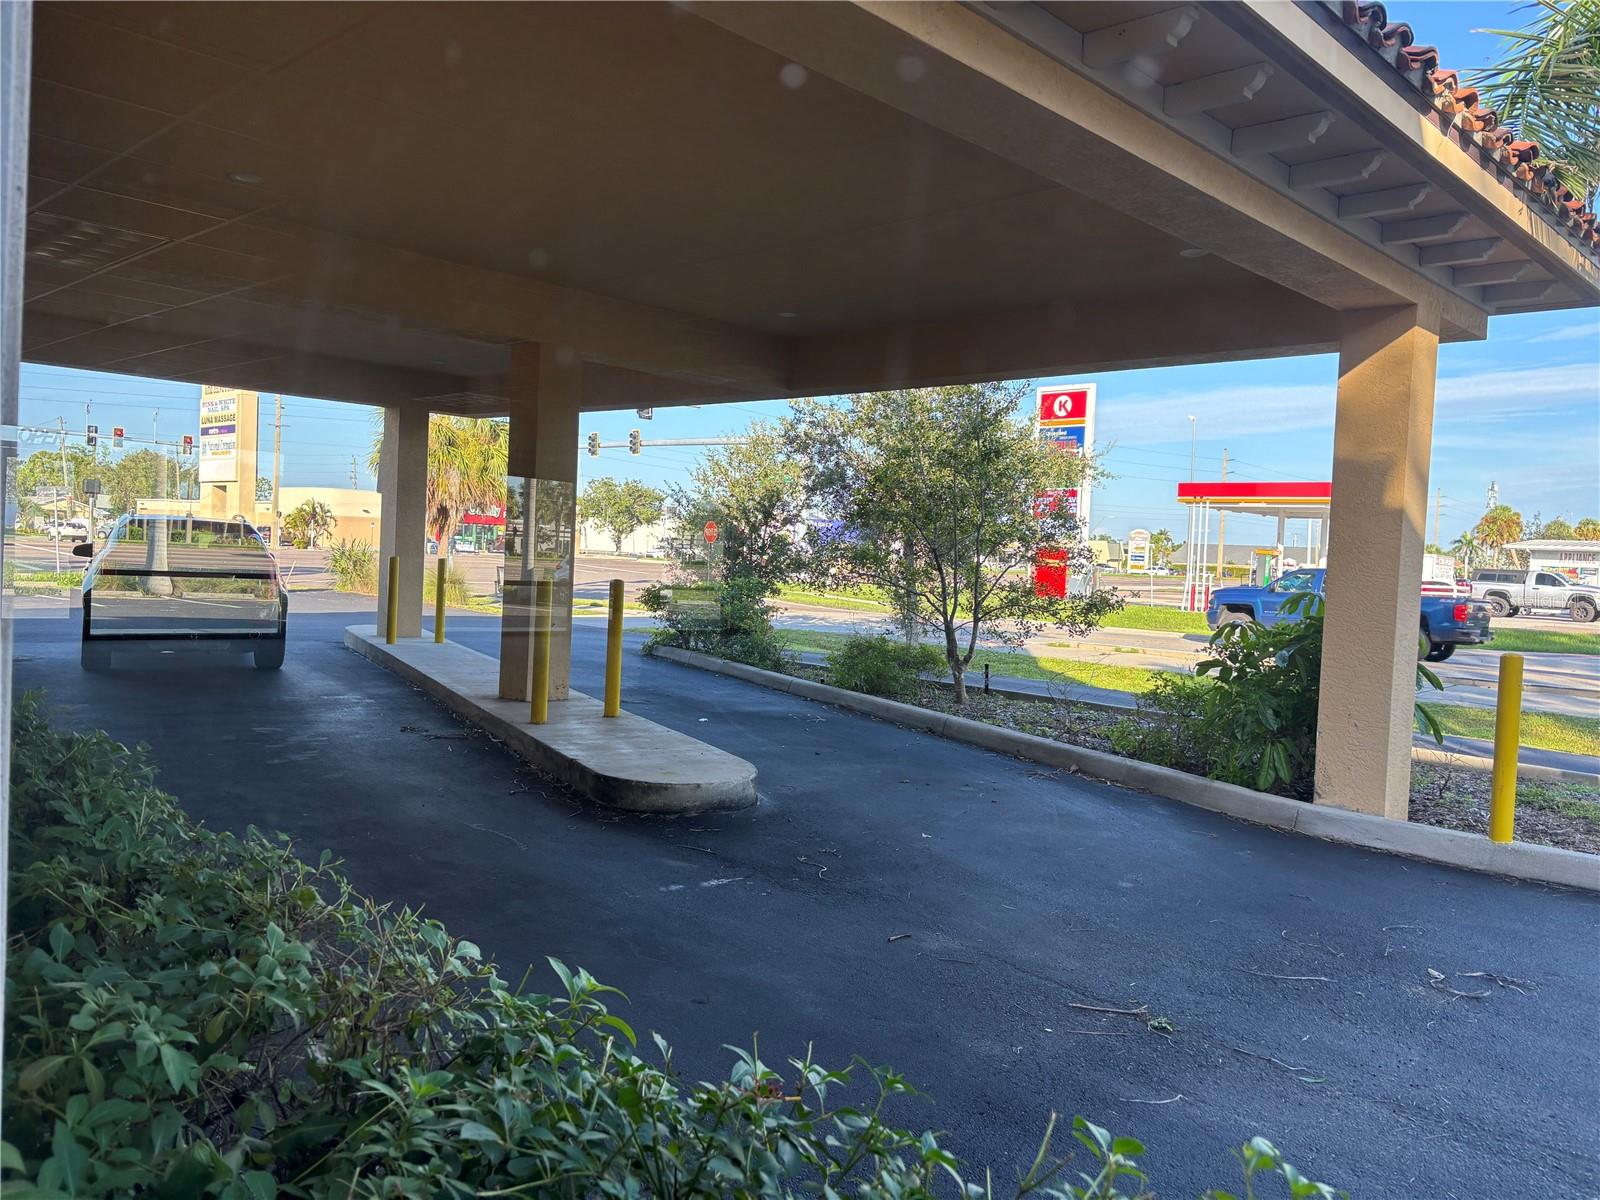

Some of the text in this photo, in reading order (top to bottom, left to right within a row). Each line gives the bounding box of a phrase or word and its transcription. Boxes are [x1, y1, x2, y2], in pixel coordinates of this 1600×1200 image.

[201, 414, 236, 425] LUNA MASSAGE
[1559, 552, 1597, 562] APPLIANCE
